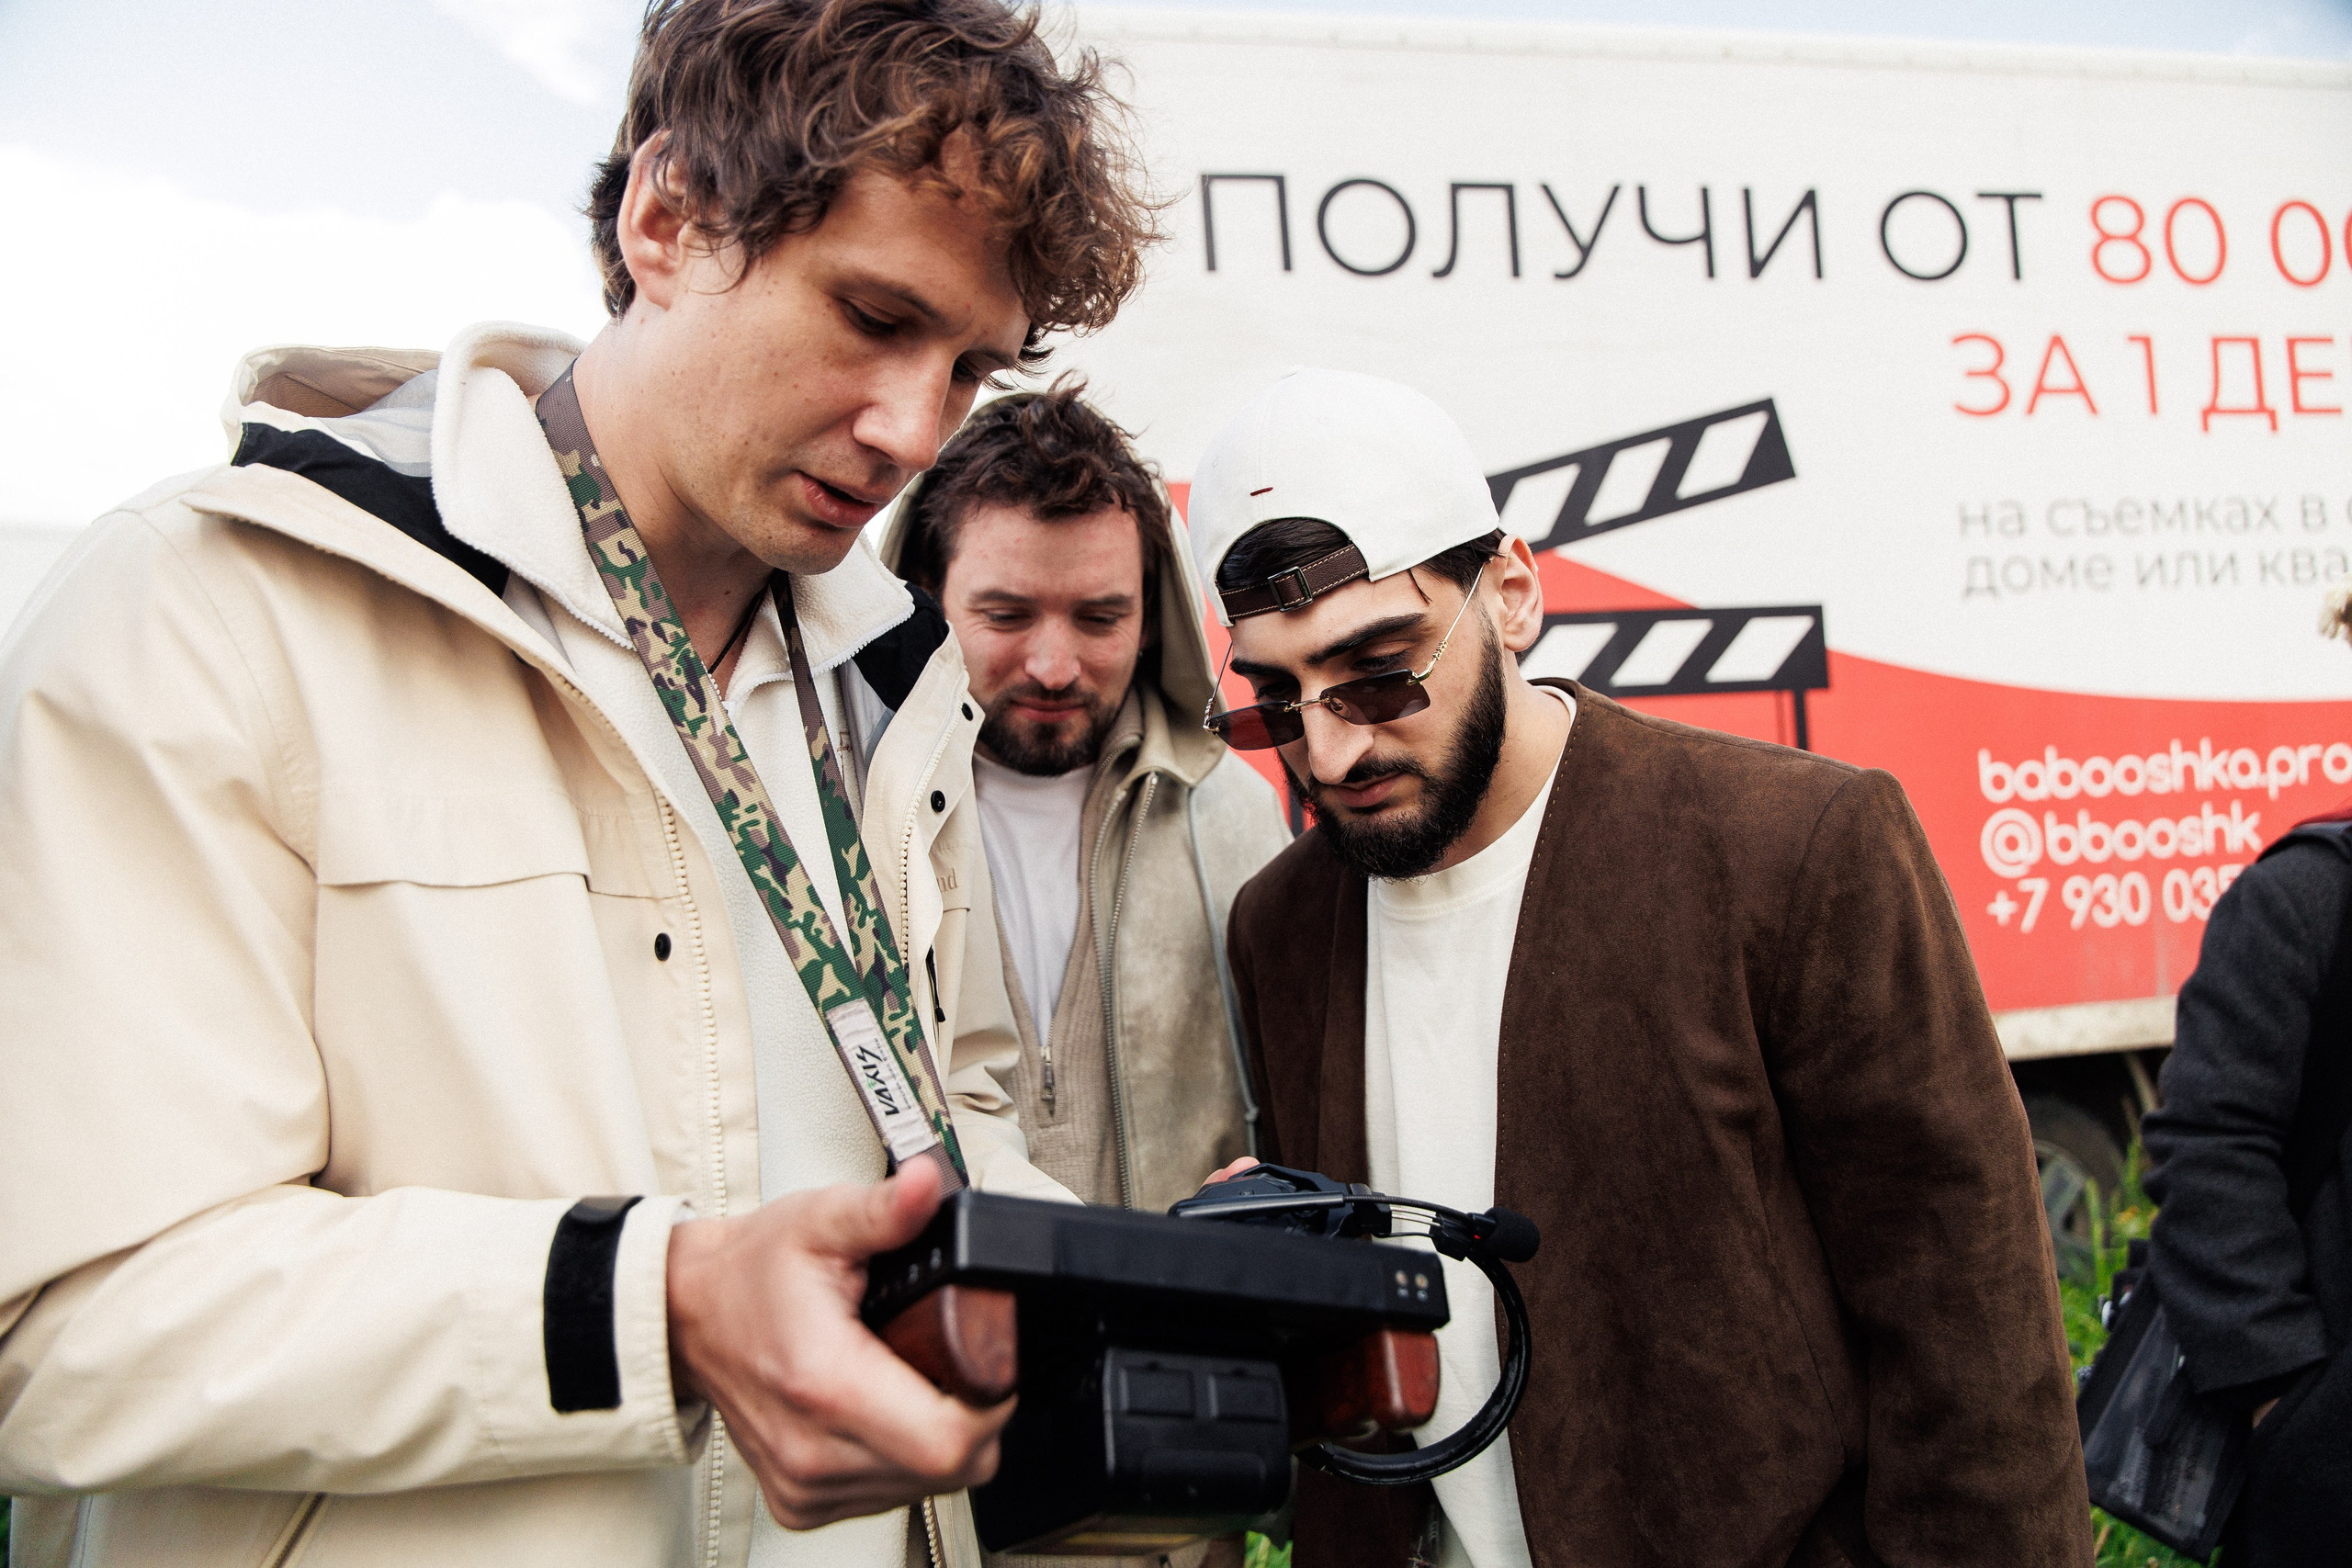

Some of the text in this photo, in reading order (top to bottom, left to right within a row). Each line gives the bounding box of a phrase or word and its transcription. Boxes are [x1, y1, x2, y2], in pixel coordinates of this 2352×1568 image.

[1201, 173, 2352, 290] ПОЛУЧИ ОТ 80 0
[1951, 331, 2352, 435] ЗА 1 ДЕ
[1957, 501, 2028, 540] на
[2045, 493, 2284, 538] съемках
[2299, 493, 2328, 533] в
[1961, 556, 2115, 600] доме
[2135, 551, 2240, 590] или
[1977, 738, 2352, 804] babooshka.pro
[1980, 799, 2263, 878] @bbooshk
[1986, 878, 2050, 933] +7
[2062, 871, 2152, 931] 930
[855, 1044, 900, 1116] VAXIS
